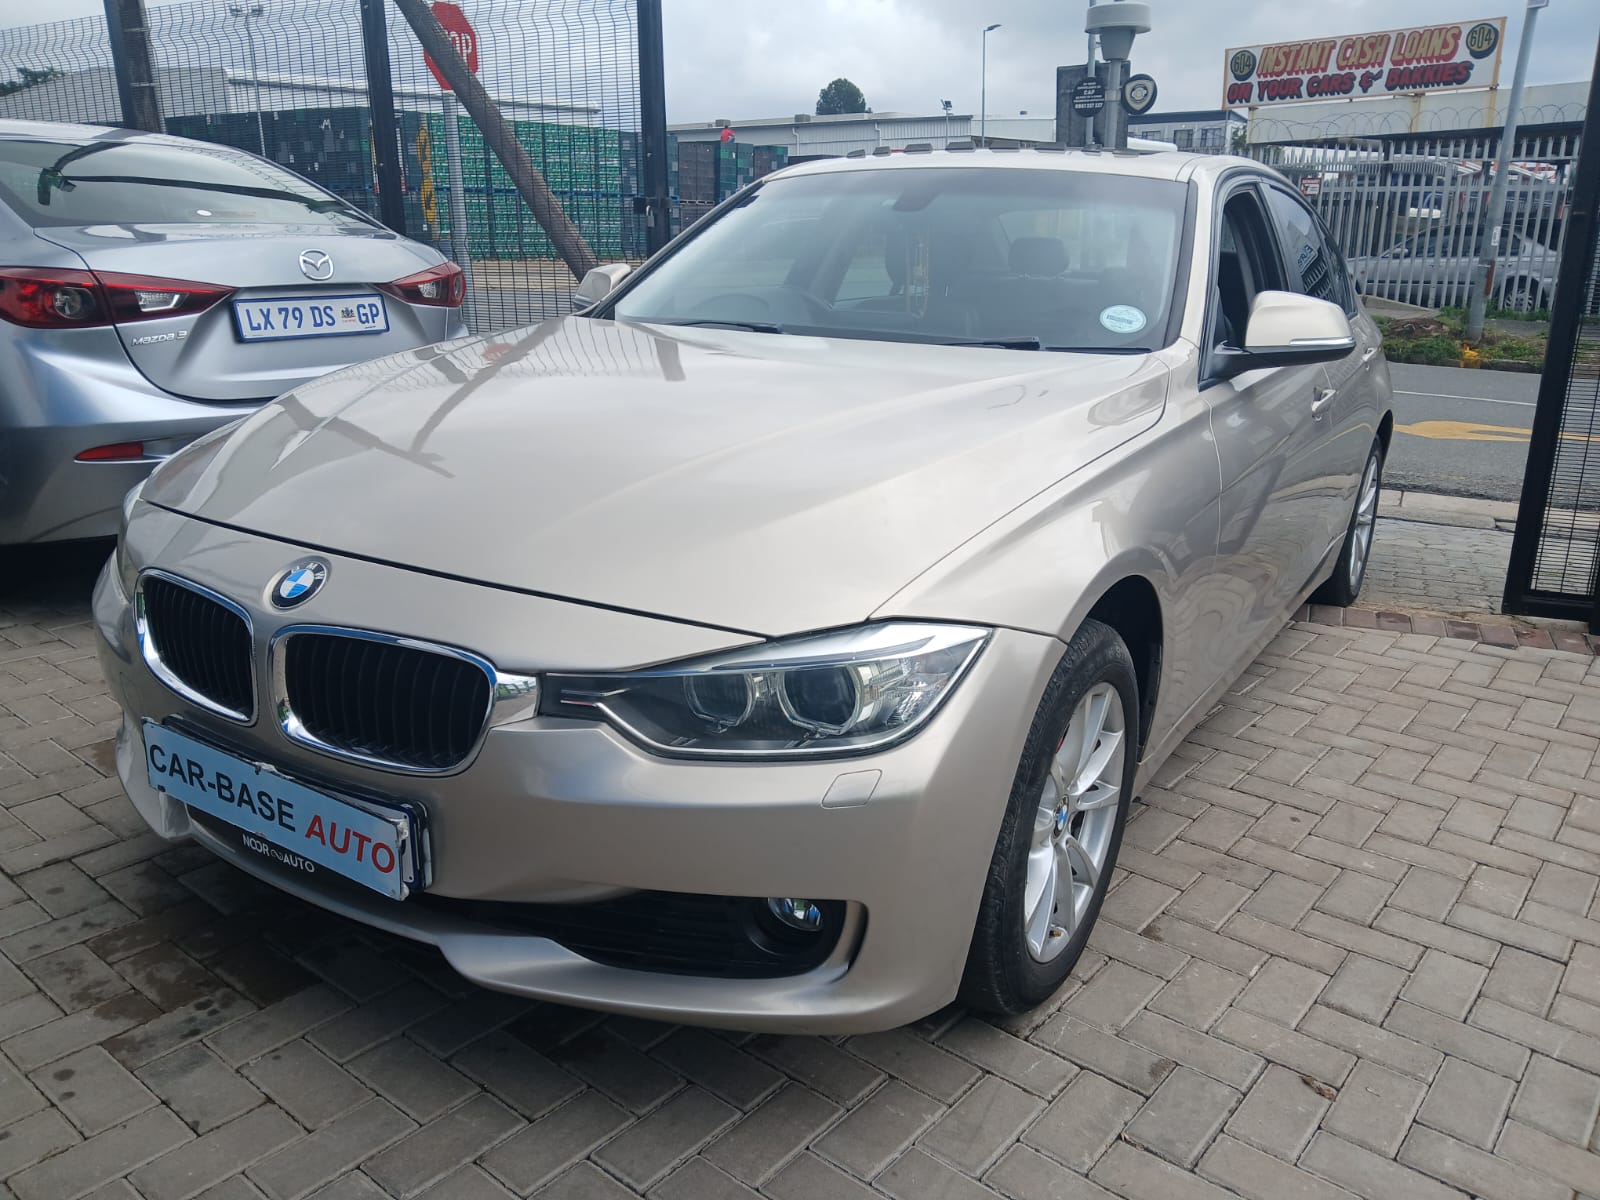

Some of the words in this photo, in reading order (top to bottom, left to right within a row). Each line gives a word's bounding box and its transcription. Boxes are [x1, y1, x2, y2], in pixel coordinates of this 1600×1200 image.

[1256, 40, 1337, 78] INSTANT
[1336, 34, 1392, 70] CASH
[1390, 26, 1462, 67] LOANS
[1471, 26, 1493, 49] 604
[1233, 53, 1252, 74] 604
[1227, 82, 1254, 104] ON
[1257, 77, 1303, 102] YOUR
[1306, 72, 1356, 97] CARS
[1384, 60, 1474, 91] BAKKIES
[246, 308, 275, 331] LX
[278, 307, 303, 329] 79
[309, 305, 336, 328] DS
[356, 303, 380, 325] GP
[176, 330, 188, 339] 3
[150, 744, 296, 832] CAR-BASE
[305, 815, 395, 873] AUTO
[242, 833, 270, 857] NOOR
[283, 853, 315, 873] AUTO
